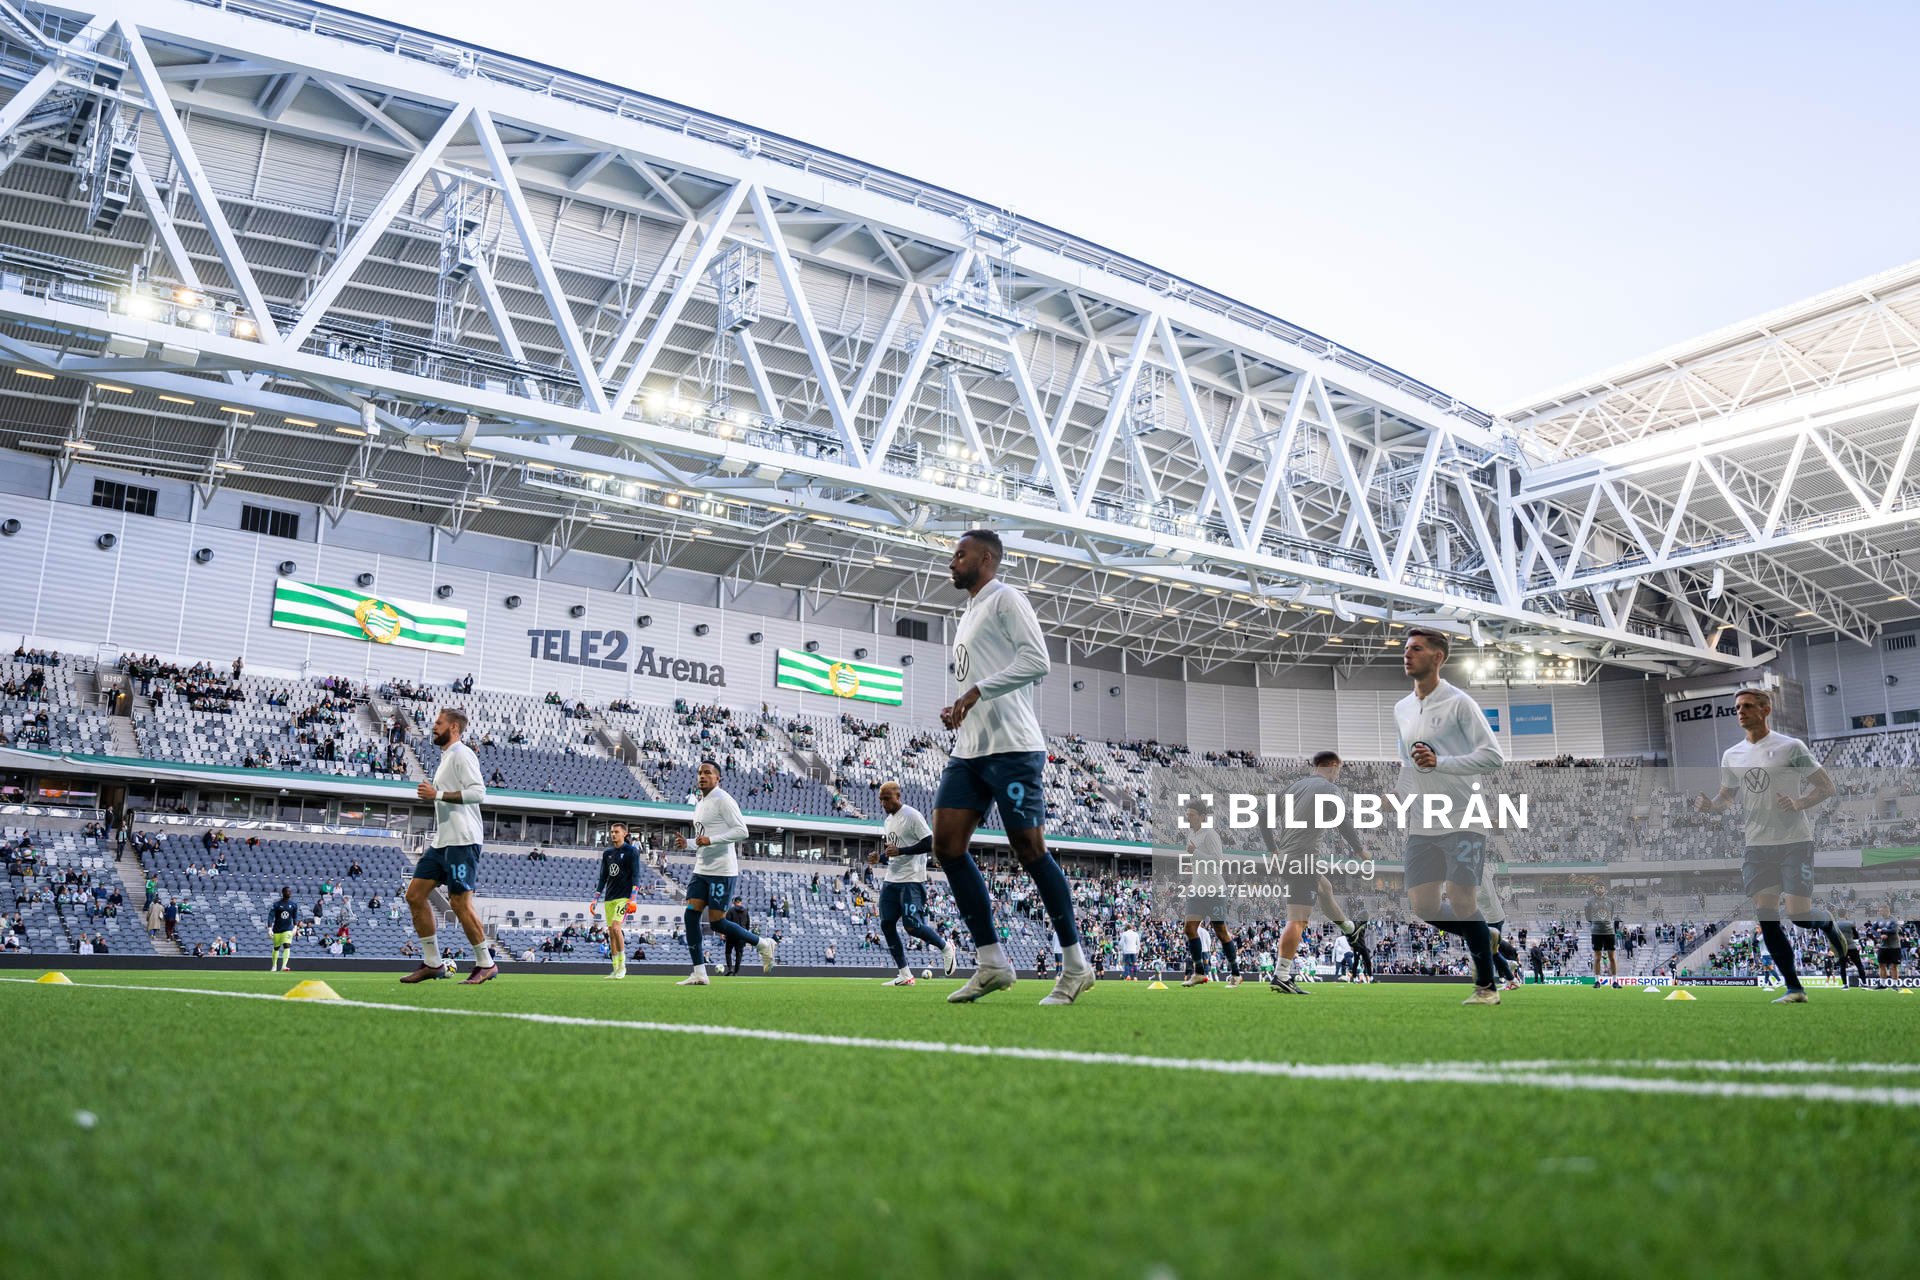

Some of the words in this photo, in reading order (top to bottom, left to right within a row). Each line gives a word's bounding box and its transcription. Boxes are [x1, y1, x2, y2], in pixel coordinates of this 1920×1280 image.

[528, 629, 629, 672] TELE2
[634, 645, 727, 688] Arena
[1674, 703, 1713, 723] TELE2
[1006, 782, 1024, 808] 9
[450, 864, 466, 880] 18
[1801, 863, 1812, 881] 5
[710, 883, 724, 898] 13
[616, 905, 625, 915] 16
[905, 903, 916, 916] 19
